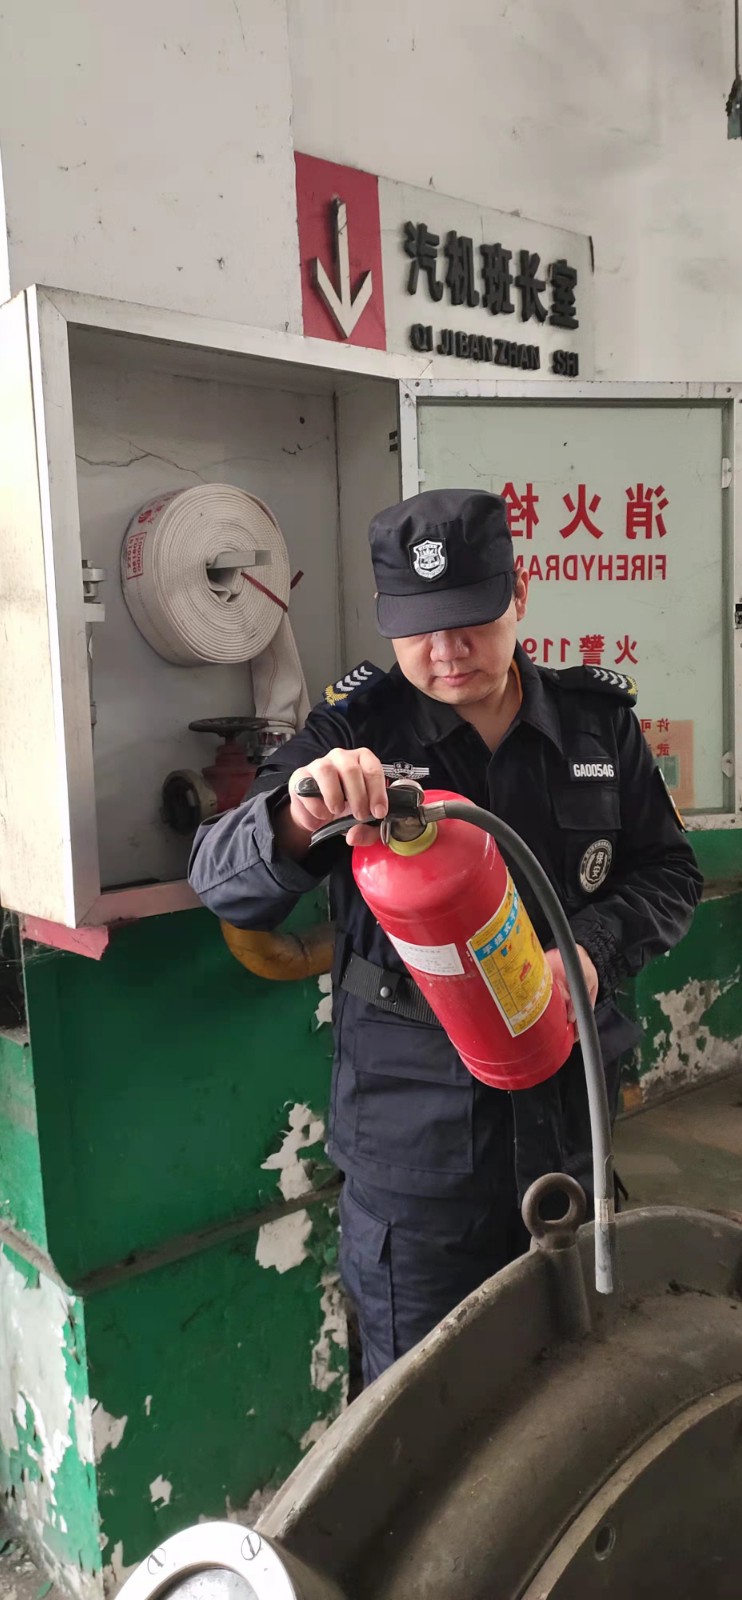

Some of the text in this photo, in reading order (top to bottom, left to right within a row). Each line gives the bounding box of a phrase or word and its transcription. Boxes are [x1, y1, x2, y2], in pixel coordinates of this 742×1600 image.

[404, 220, 579, 330] 汽机班长室
[573, 764, 615, 778] GA00546
